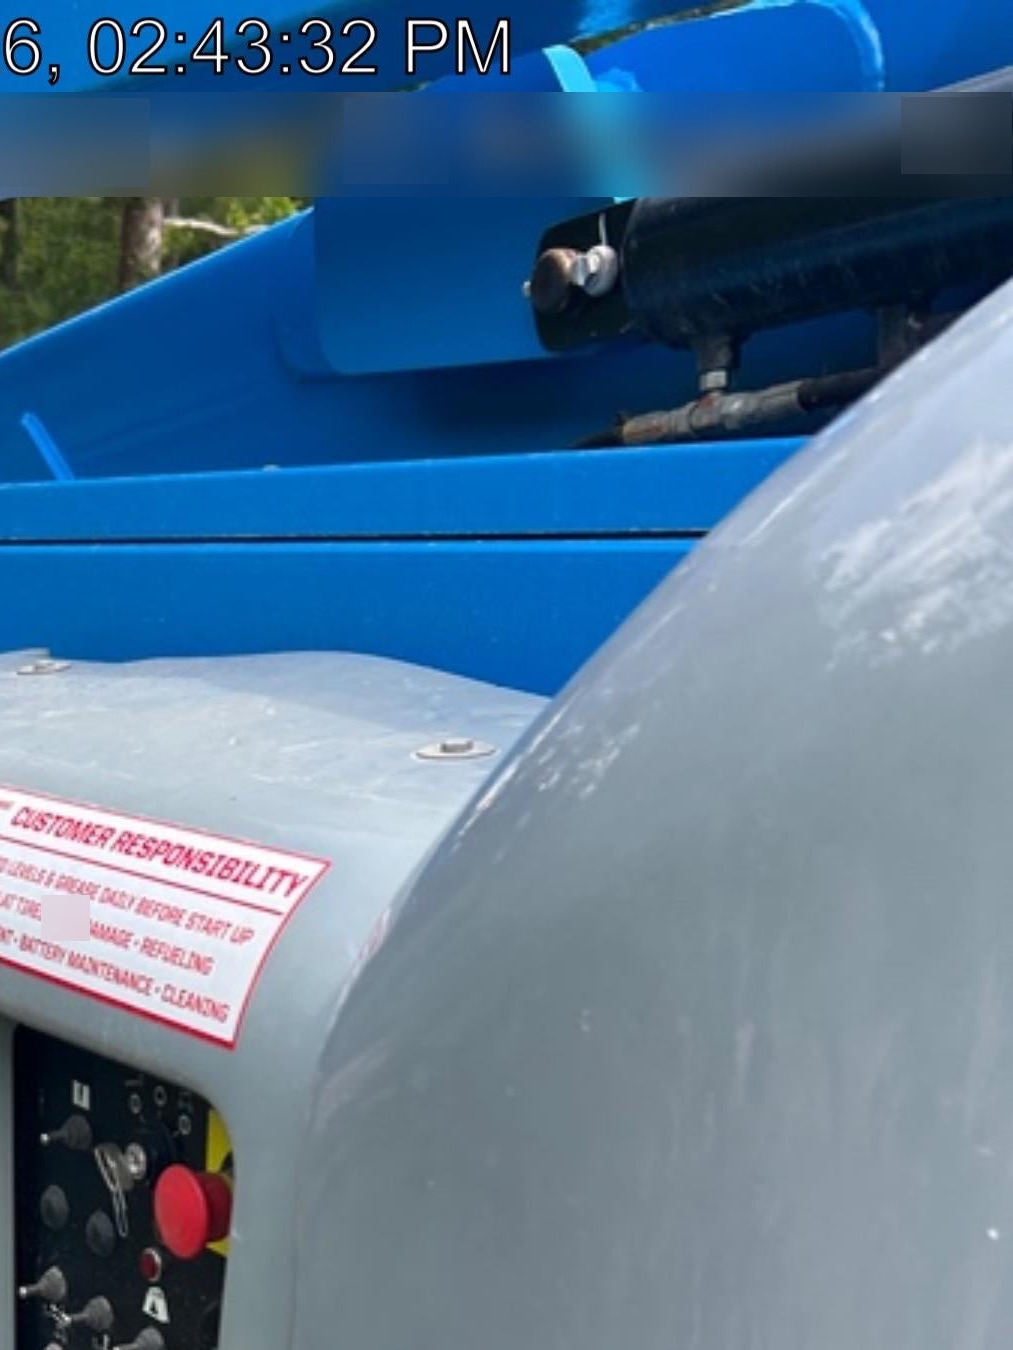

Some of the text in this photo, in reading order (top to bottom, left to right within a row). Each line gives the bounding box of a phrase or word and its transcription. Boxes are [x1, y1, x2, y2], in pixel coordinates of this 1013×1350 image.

[11, 806, 309, 897] CUSTOMER RESPONSIBILITY
[7, 861, 47, 885] LEVELS
[55, 875, 101, 900] GREASE
[98, 887, 135, 910] DAILY
[135, 897, 187, 927] BEFORE
[185, 912, 232, 939] START
[230, 927, 255, 944] UP
[19, 933, 66, 962] BATTERY
[66, 950, 154, 996] MAINTENANCE
[161, 983, 230, 1023] CLEANING
[90, 919, 215, 975] AMAGE REFUELING
